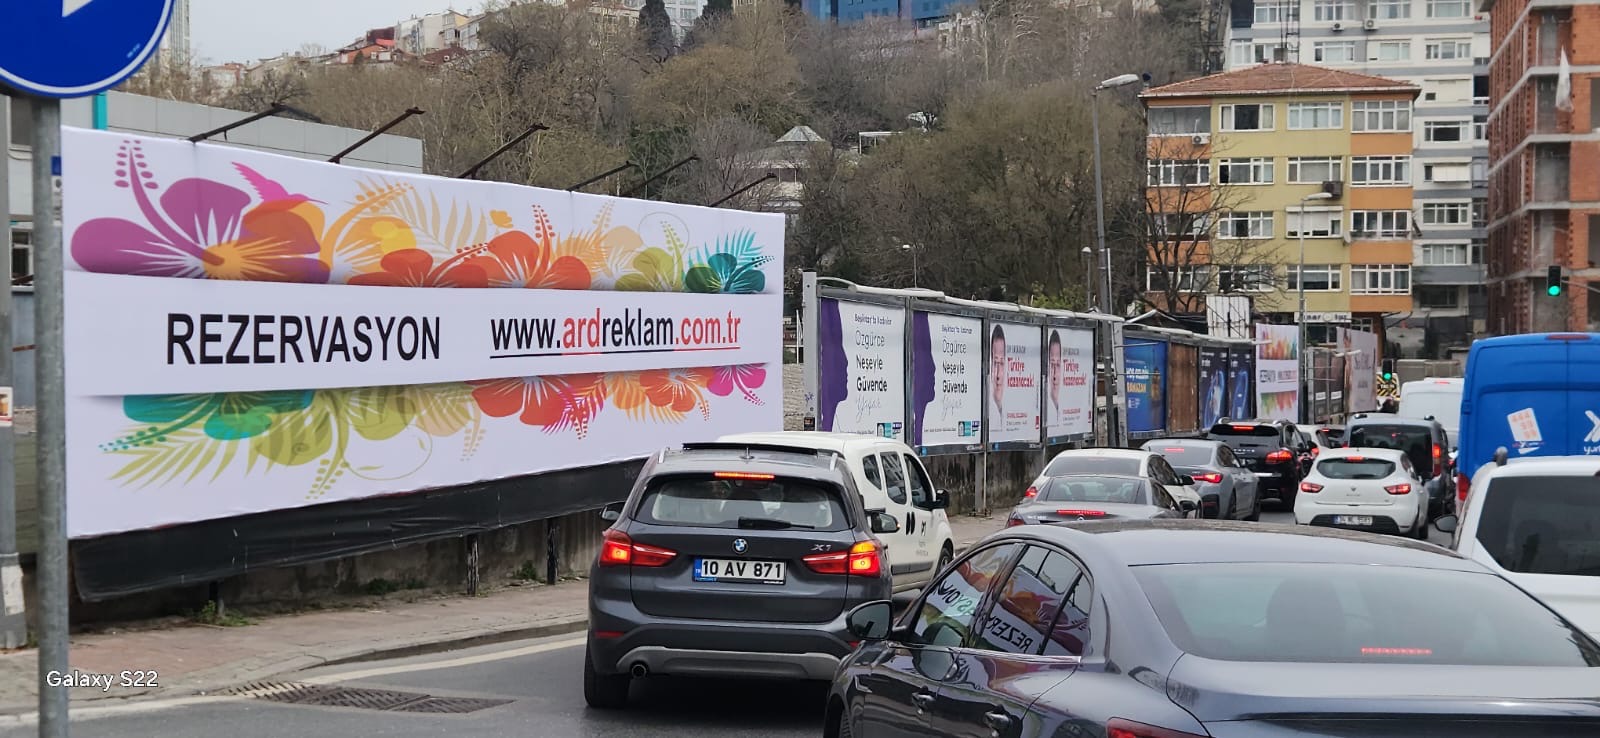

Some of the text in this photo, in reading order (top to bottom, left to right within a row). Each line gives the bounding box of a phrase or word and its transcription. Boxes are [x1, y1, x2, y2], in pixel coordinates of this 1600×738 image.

[490, 307, 741, 351] www.ardreklam.com.tr
[167, 313, 440, 364] REZERVASYON
[855, 327, 885, 350] Özgürce
[942, 336, 967, 356] Özgürce
[856, 354, 883, 373] Neşeyle
[942, 360, 965, 377] Neşeyle
[1007, 357, 1024, 375] Türkiye
[856, 376, 888, 392] Güvende
[942, 380, 968, 393] Güvende
[703, 560, 718, 575] 10
[724, 562, 746, 577] AV
[753, 563, 780, 578] 871
